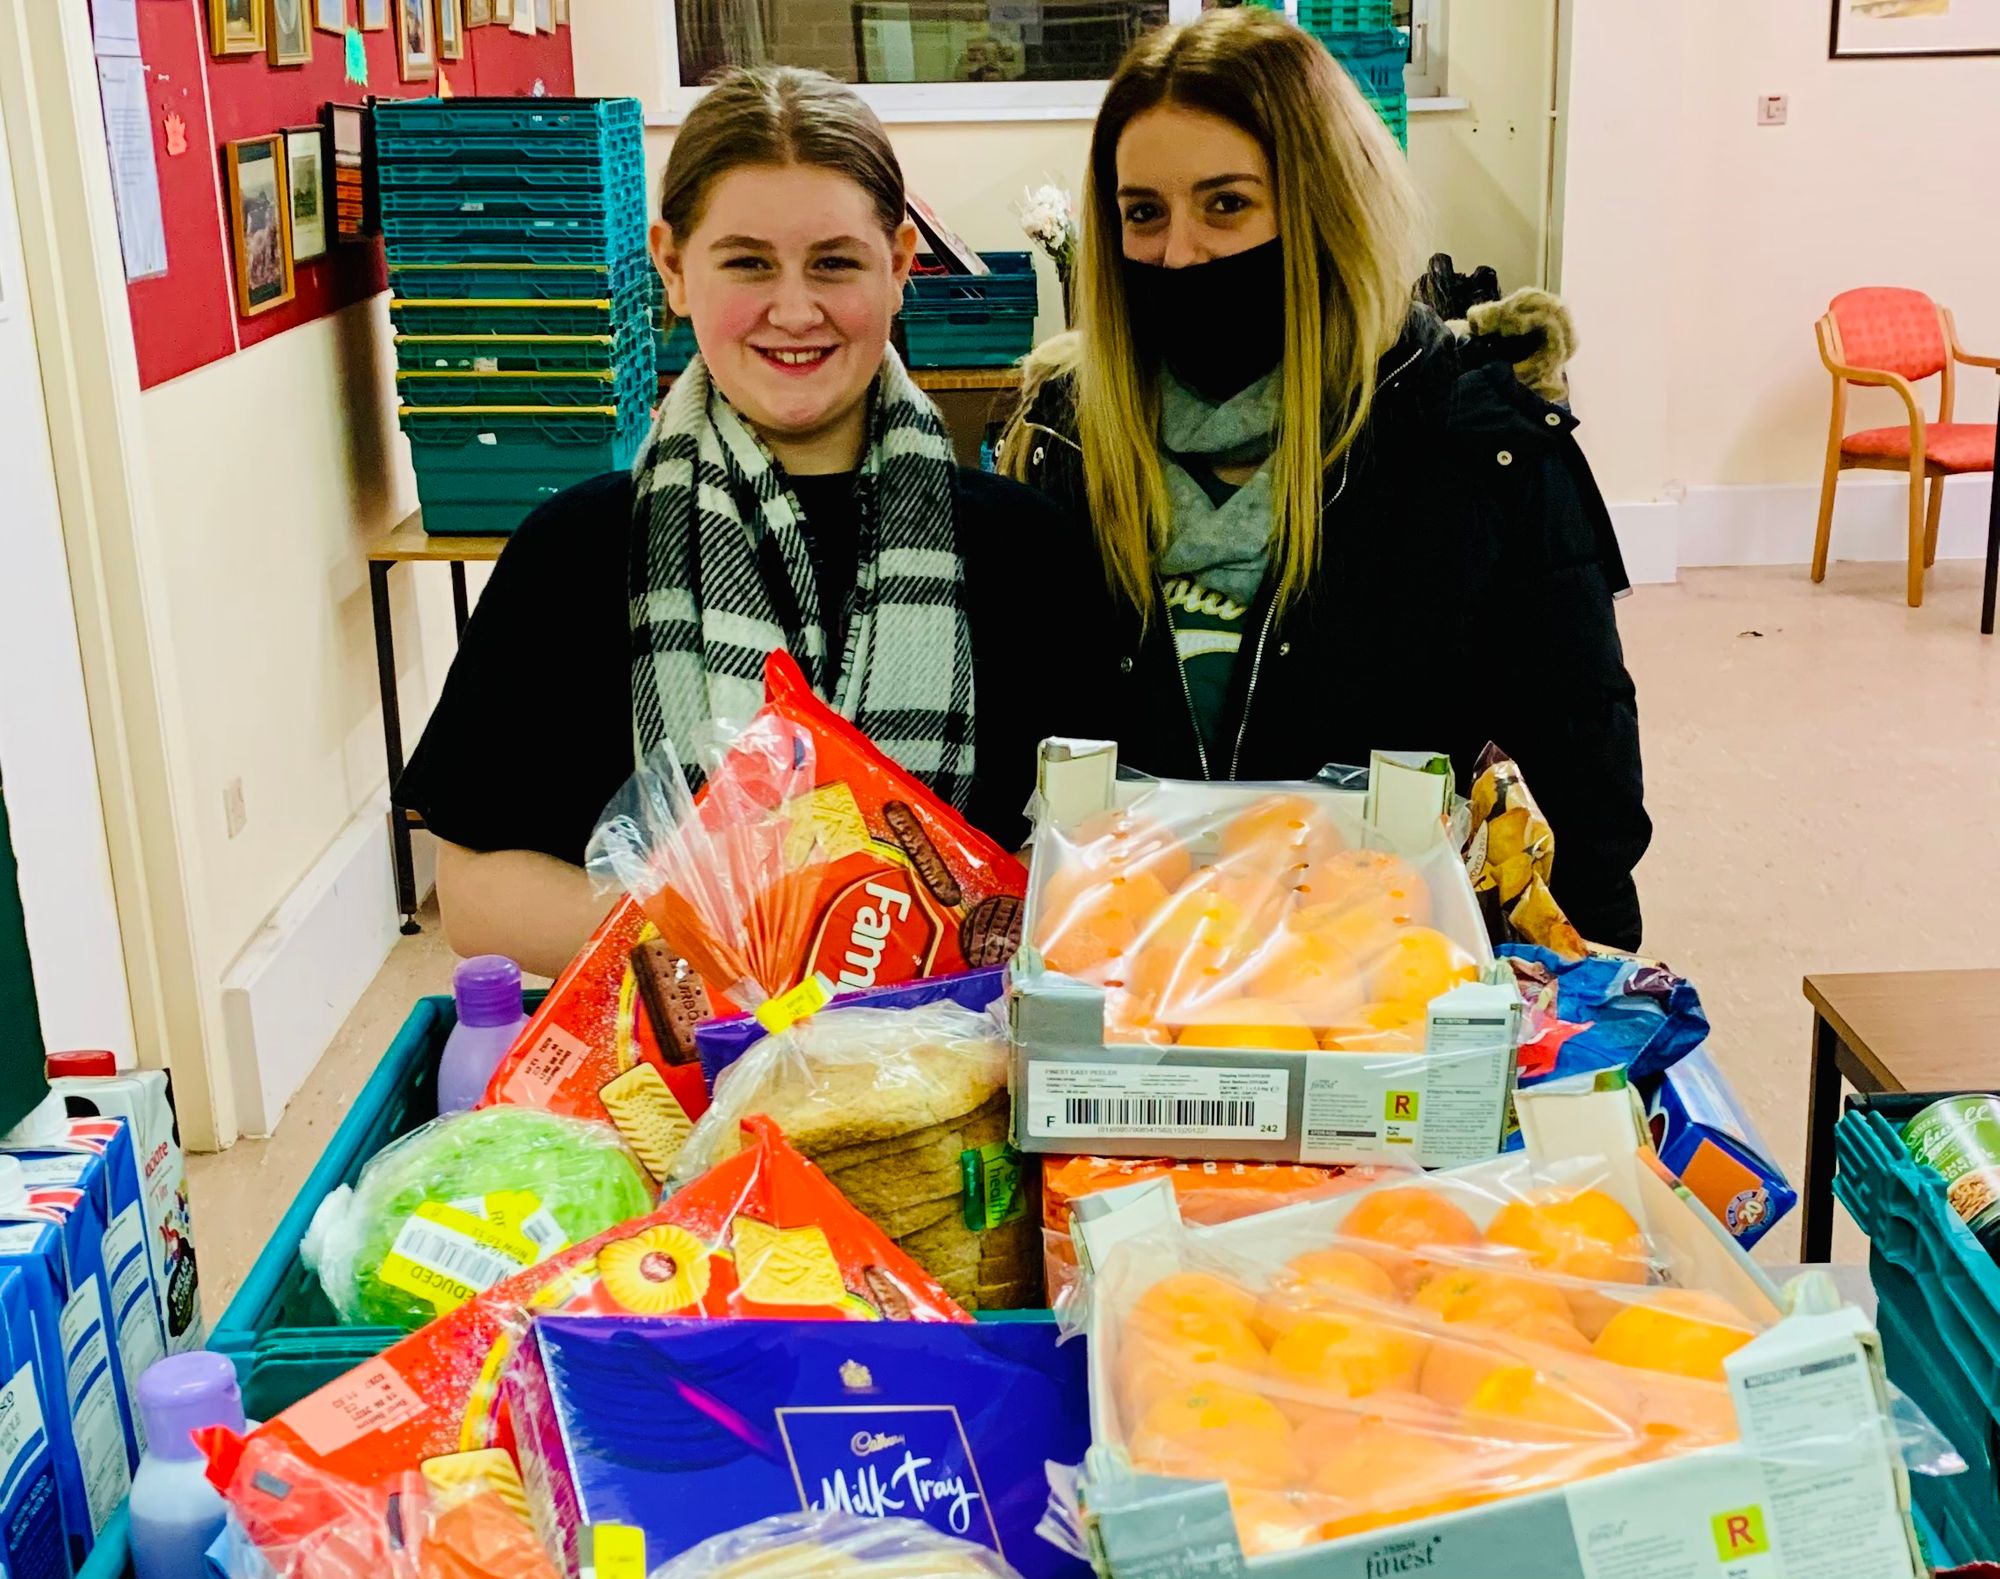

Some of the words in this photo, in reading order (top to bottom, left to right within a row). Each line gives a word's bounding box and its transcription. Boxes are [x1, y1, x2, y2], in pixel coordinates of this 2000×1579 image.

[832, 881, 912, 993] Fam
[1046, 1115, 1056, 1128] F
[1394, 1094, 1411, 1115] R
[1260, 1124, 1278, 1133] 242
[990, 1165, 1006, 1221] health
[1739, 1199, 1764, 1224] 20
[410, 1264, 478, 1301] EDUCED
[810, 1463, 905, 1518] Milk
[891, 1450, 980, 1534] Tray
[1727, 1515, 1755, 1547] R
[1366, 1542, 1433, 1579] finest
